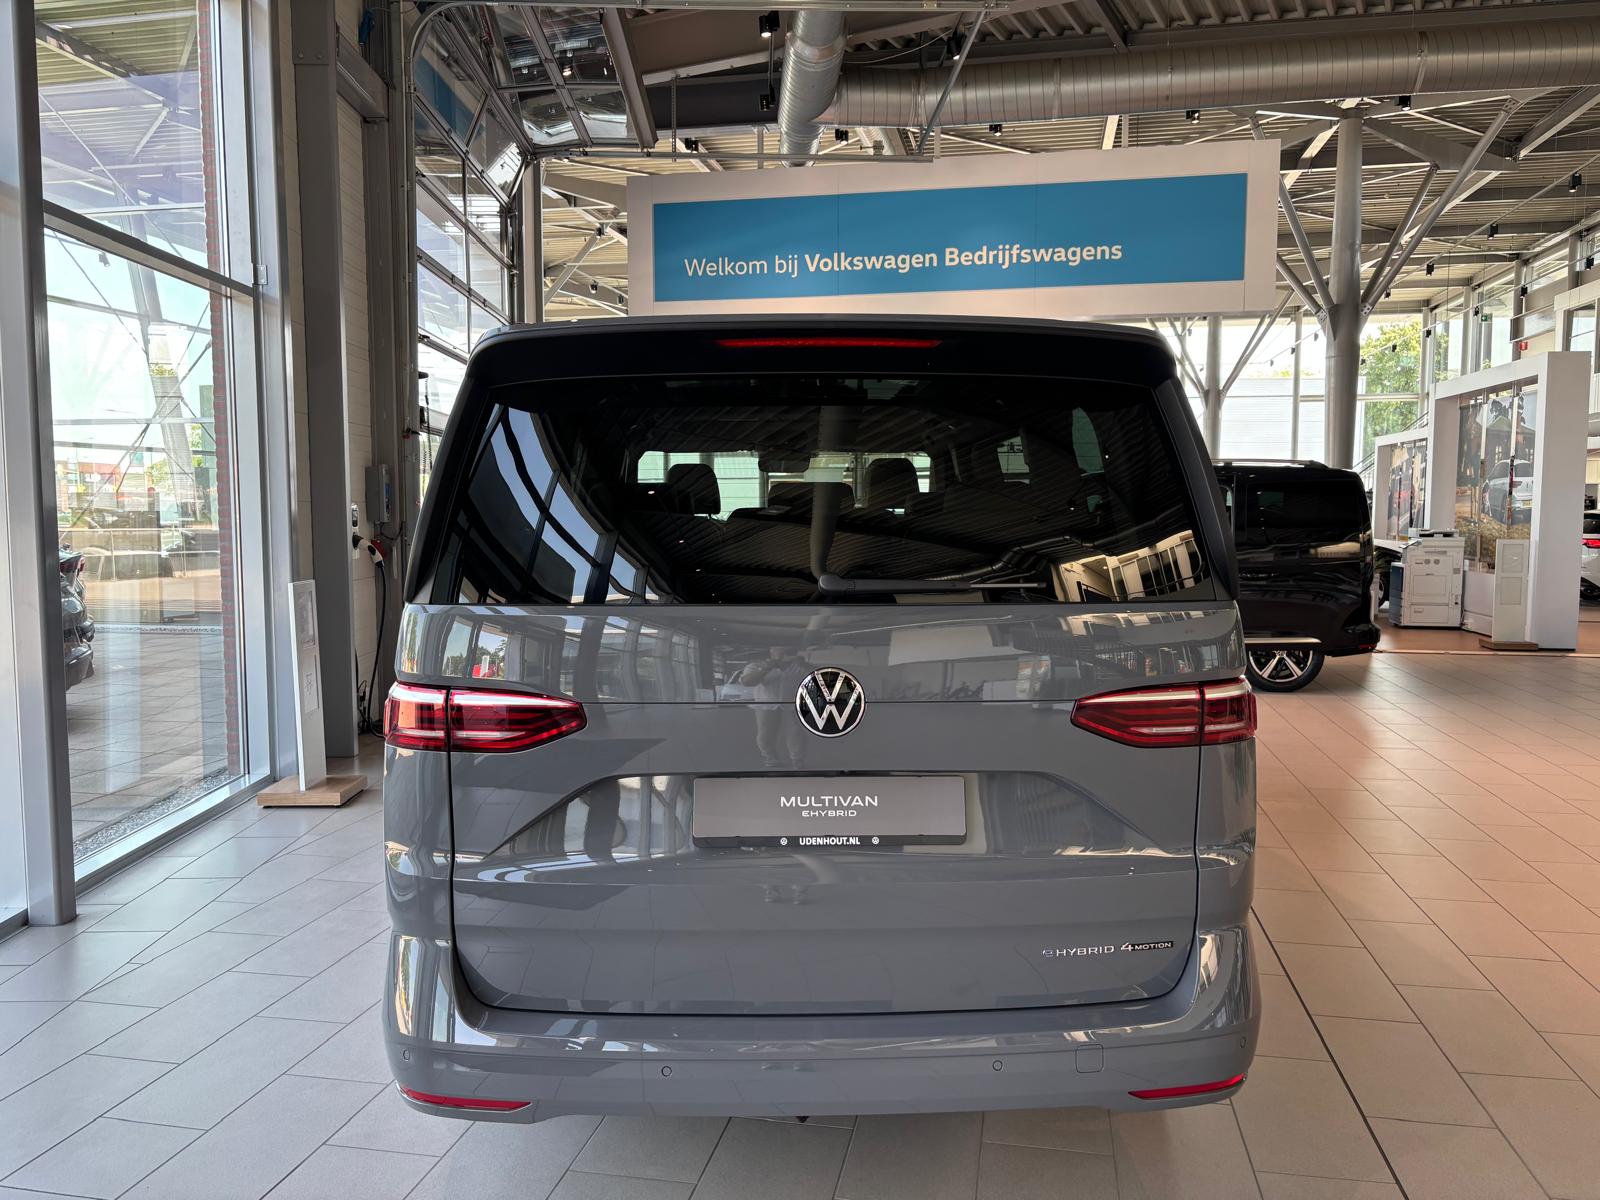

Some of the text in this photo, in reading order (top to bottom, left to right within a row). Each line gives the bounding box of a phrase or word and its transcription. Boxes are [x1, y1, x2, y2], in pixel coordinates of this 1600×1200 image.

[684, 243, 1123, 278] Welkom bij Volkswagen Bedrijfswagens
[780, 795, 879, 808] MULTIVAN
[799, 836, 861, 846] UDENHOUT.NL
[1120, 941, 1173, 952] 4MOTION
